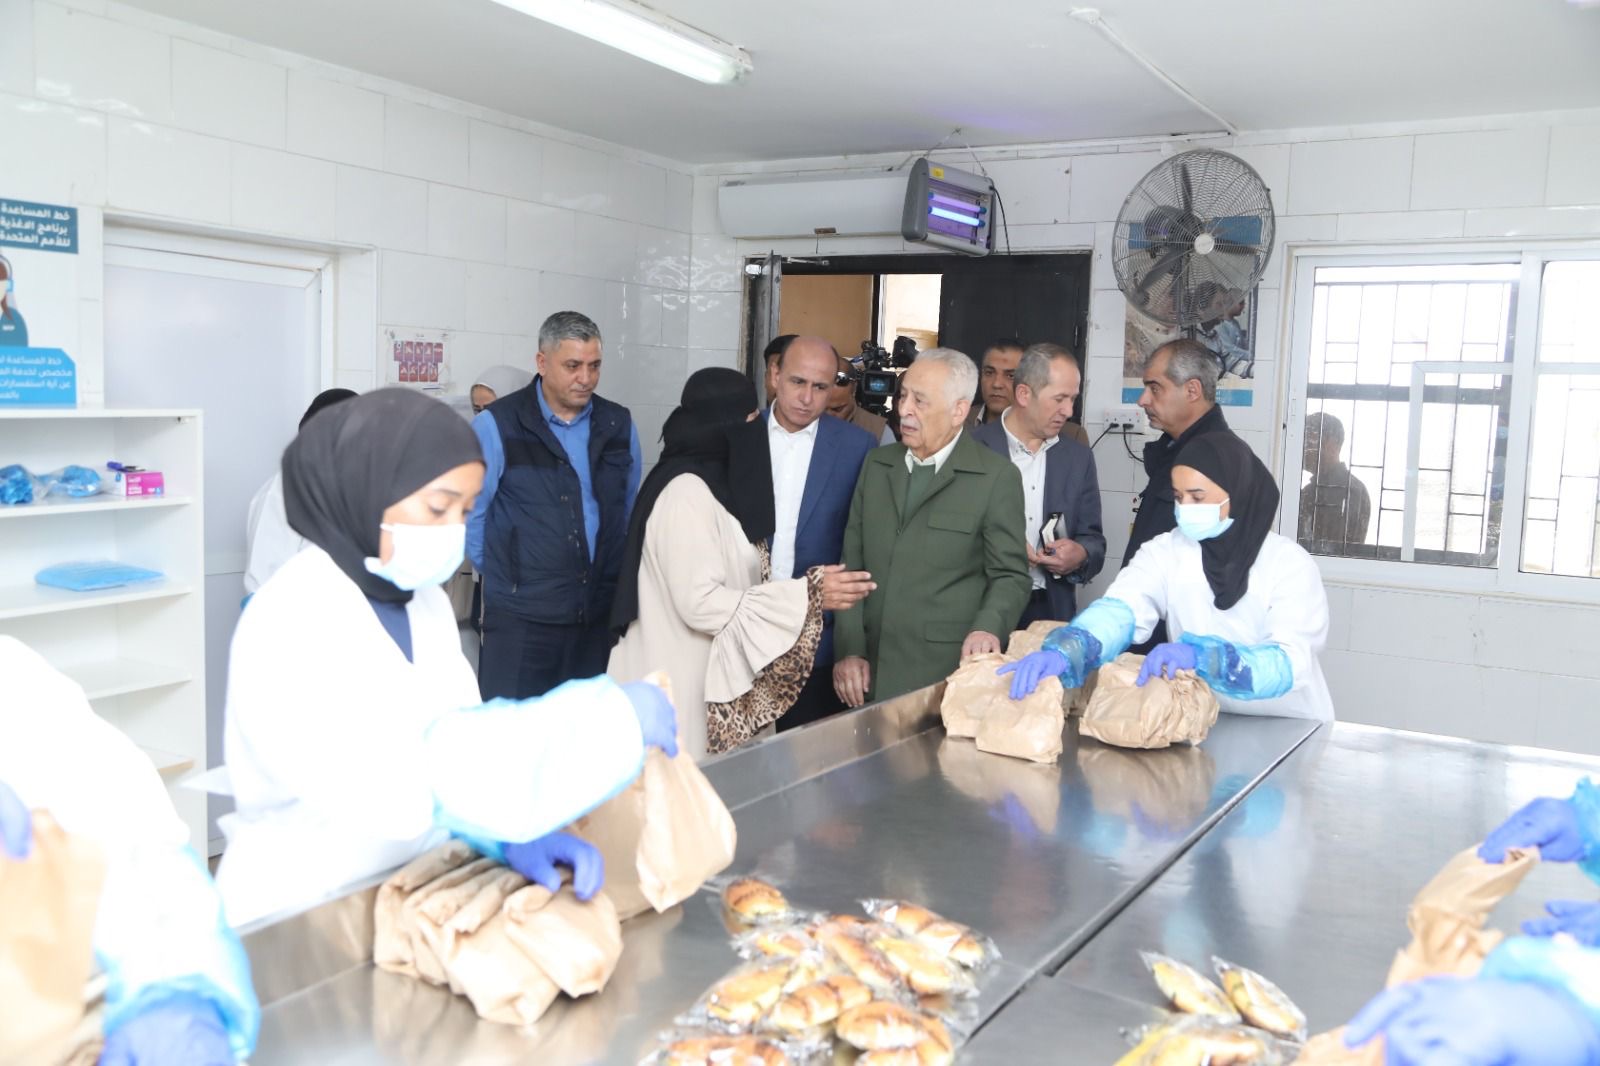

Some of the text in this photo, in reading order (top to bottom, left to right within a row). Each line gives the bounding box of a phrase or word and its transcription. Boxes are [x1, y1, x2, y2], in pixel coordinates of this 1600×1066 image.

[1, 202, 70, 221] خط المساعدة
[37, 222, 68, 236] برنامج
[0, 230, 39, 244] المتحدة
